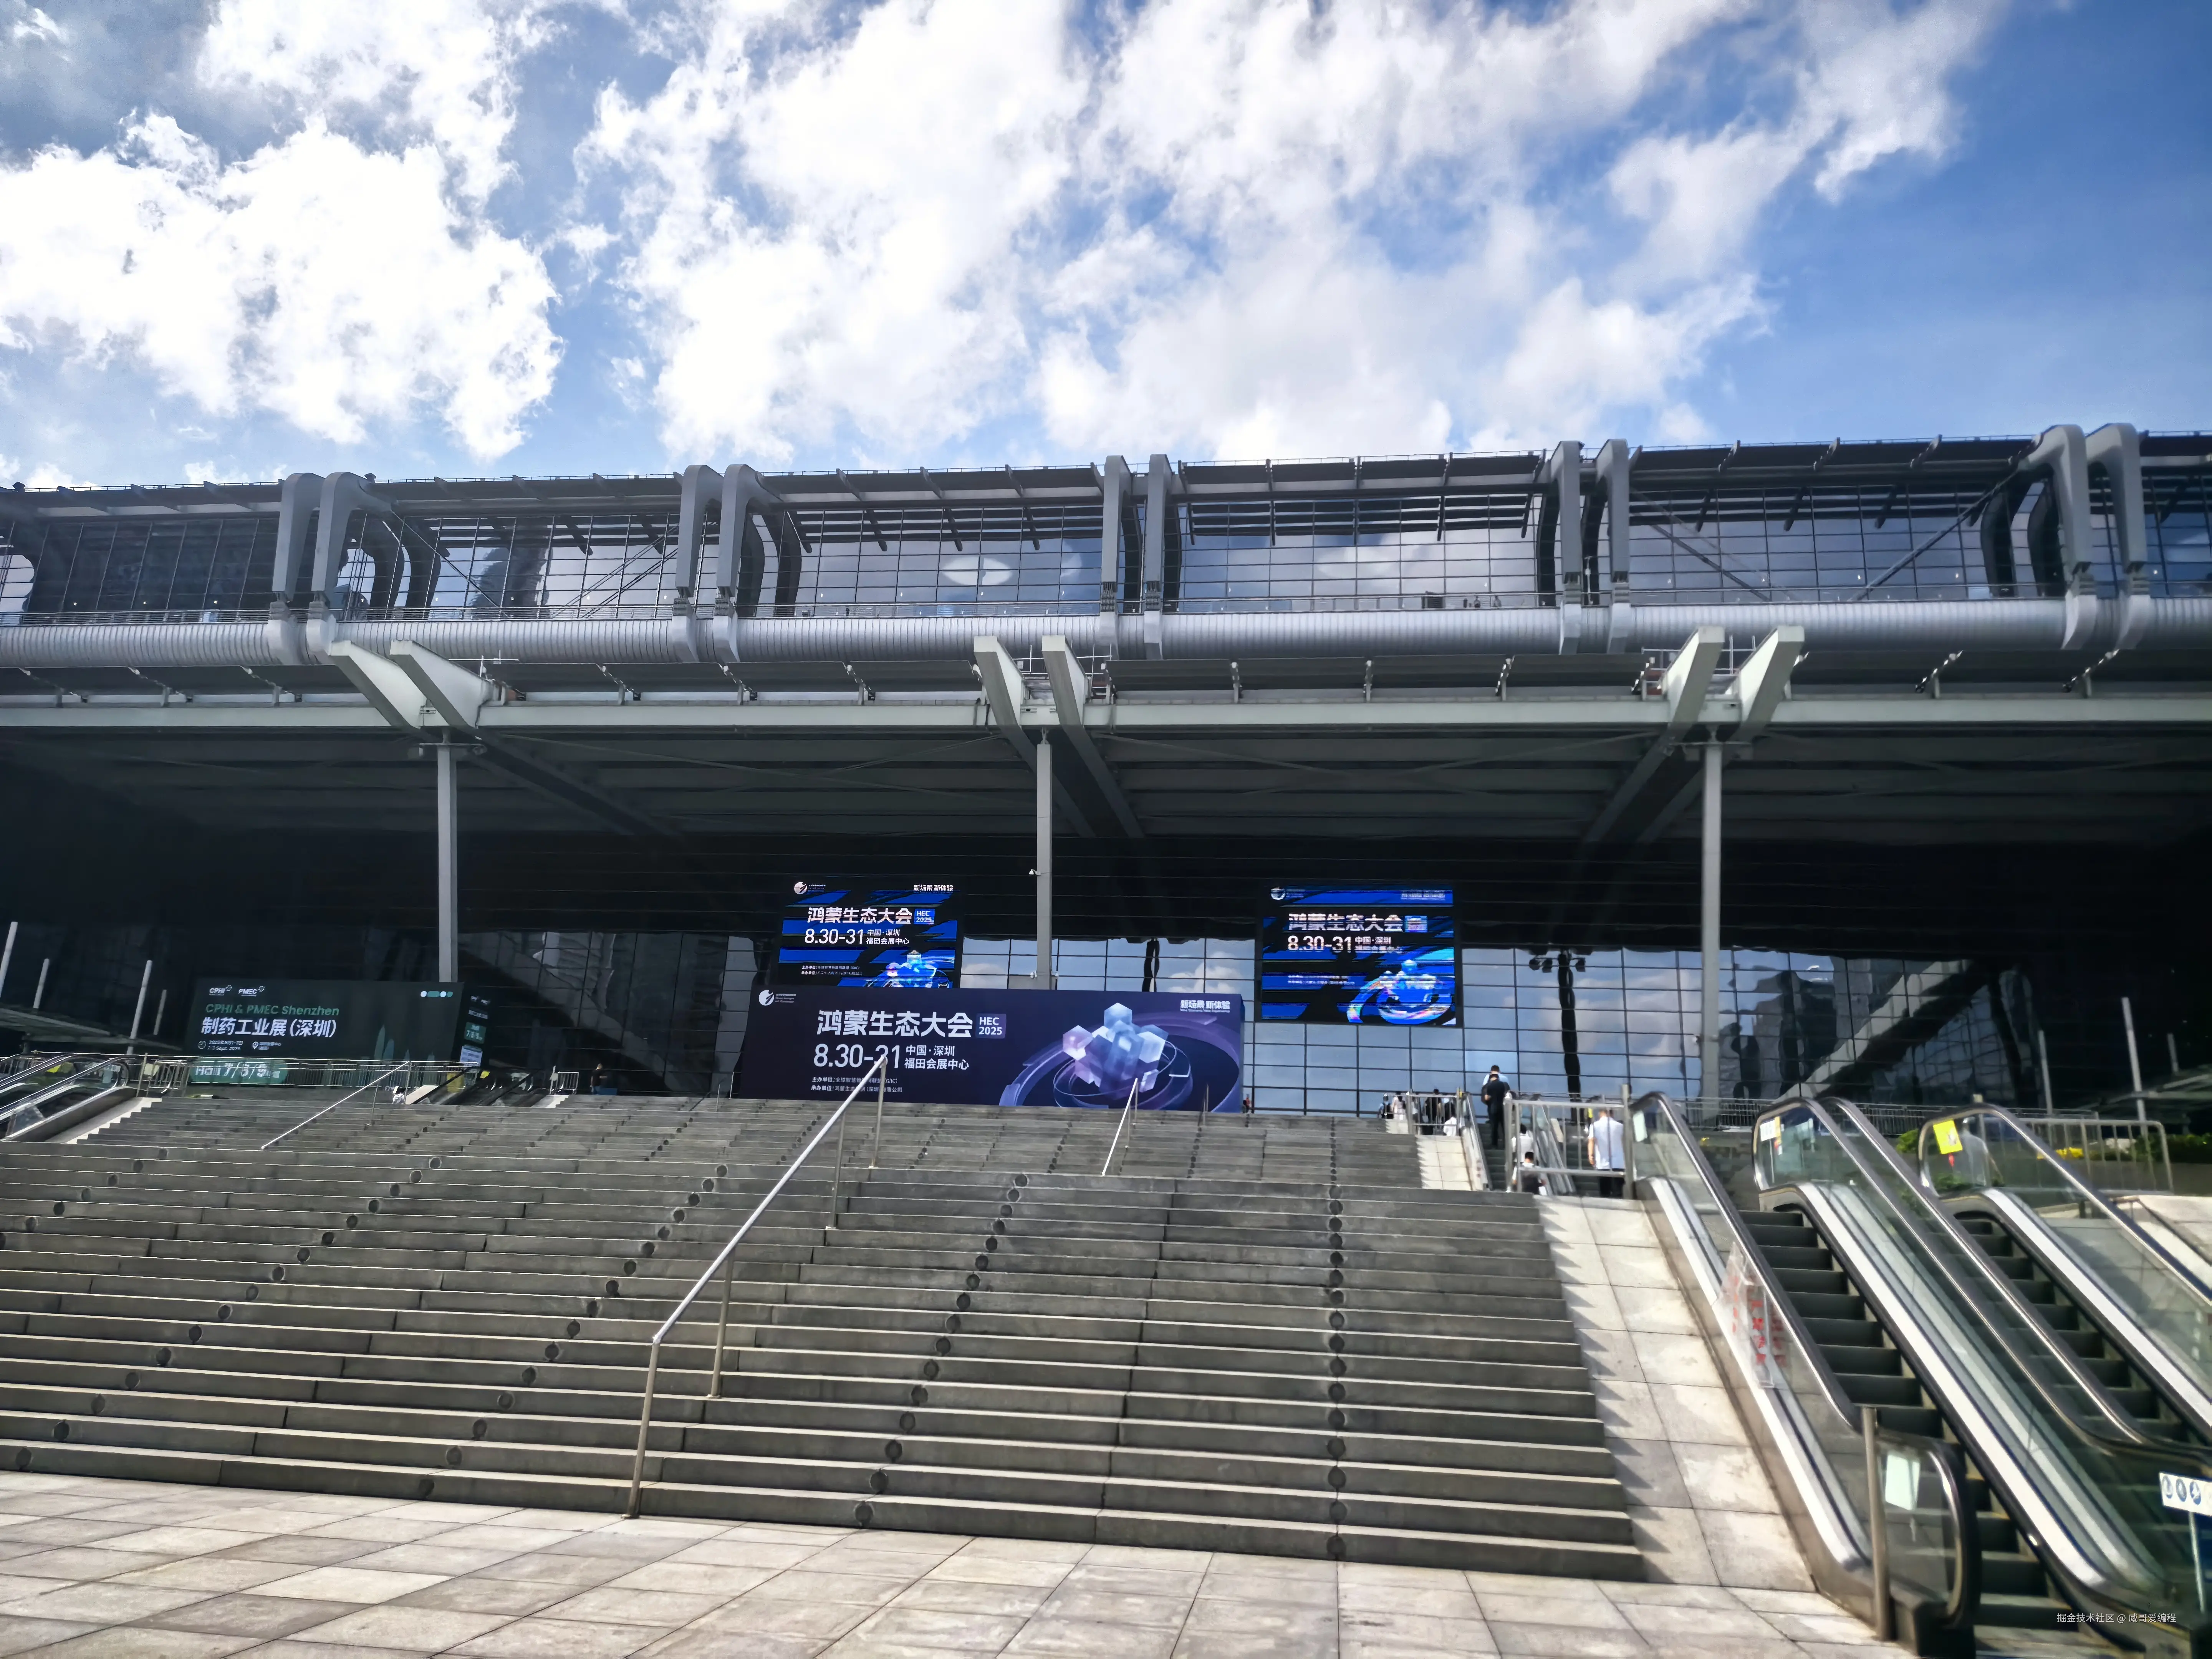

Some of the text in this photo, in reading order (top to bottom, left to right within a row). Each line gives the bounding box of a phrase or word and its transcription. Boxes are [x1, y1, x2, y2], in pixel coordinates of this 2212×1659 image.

[807, 907, 912, 924] 鸿蒙生态大会
[805, 929, 863, 944] 8.30-31
[1288, 935, 1351, 953] 8.30-31
[235, 1005, 243, 1014] &
[247, 1005, 278, 1014] PMEC
[281, 1006, 339, 1016] Shenzhen
[201, 1017, 336, 1038] 制药工业展（深圳）
[816, 1010, 973, 1037] 鸿蒙生态大会
[979, 1017, 999, 1025] HEC
[979, 1027, 1002, 1035] 2025
[813, 1043, 899, 1068] 8.30-31
[906, 1045, 955, 1056] 中国·深圳
[904, 1058, 969, 1070] 福田会展中心
